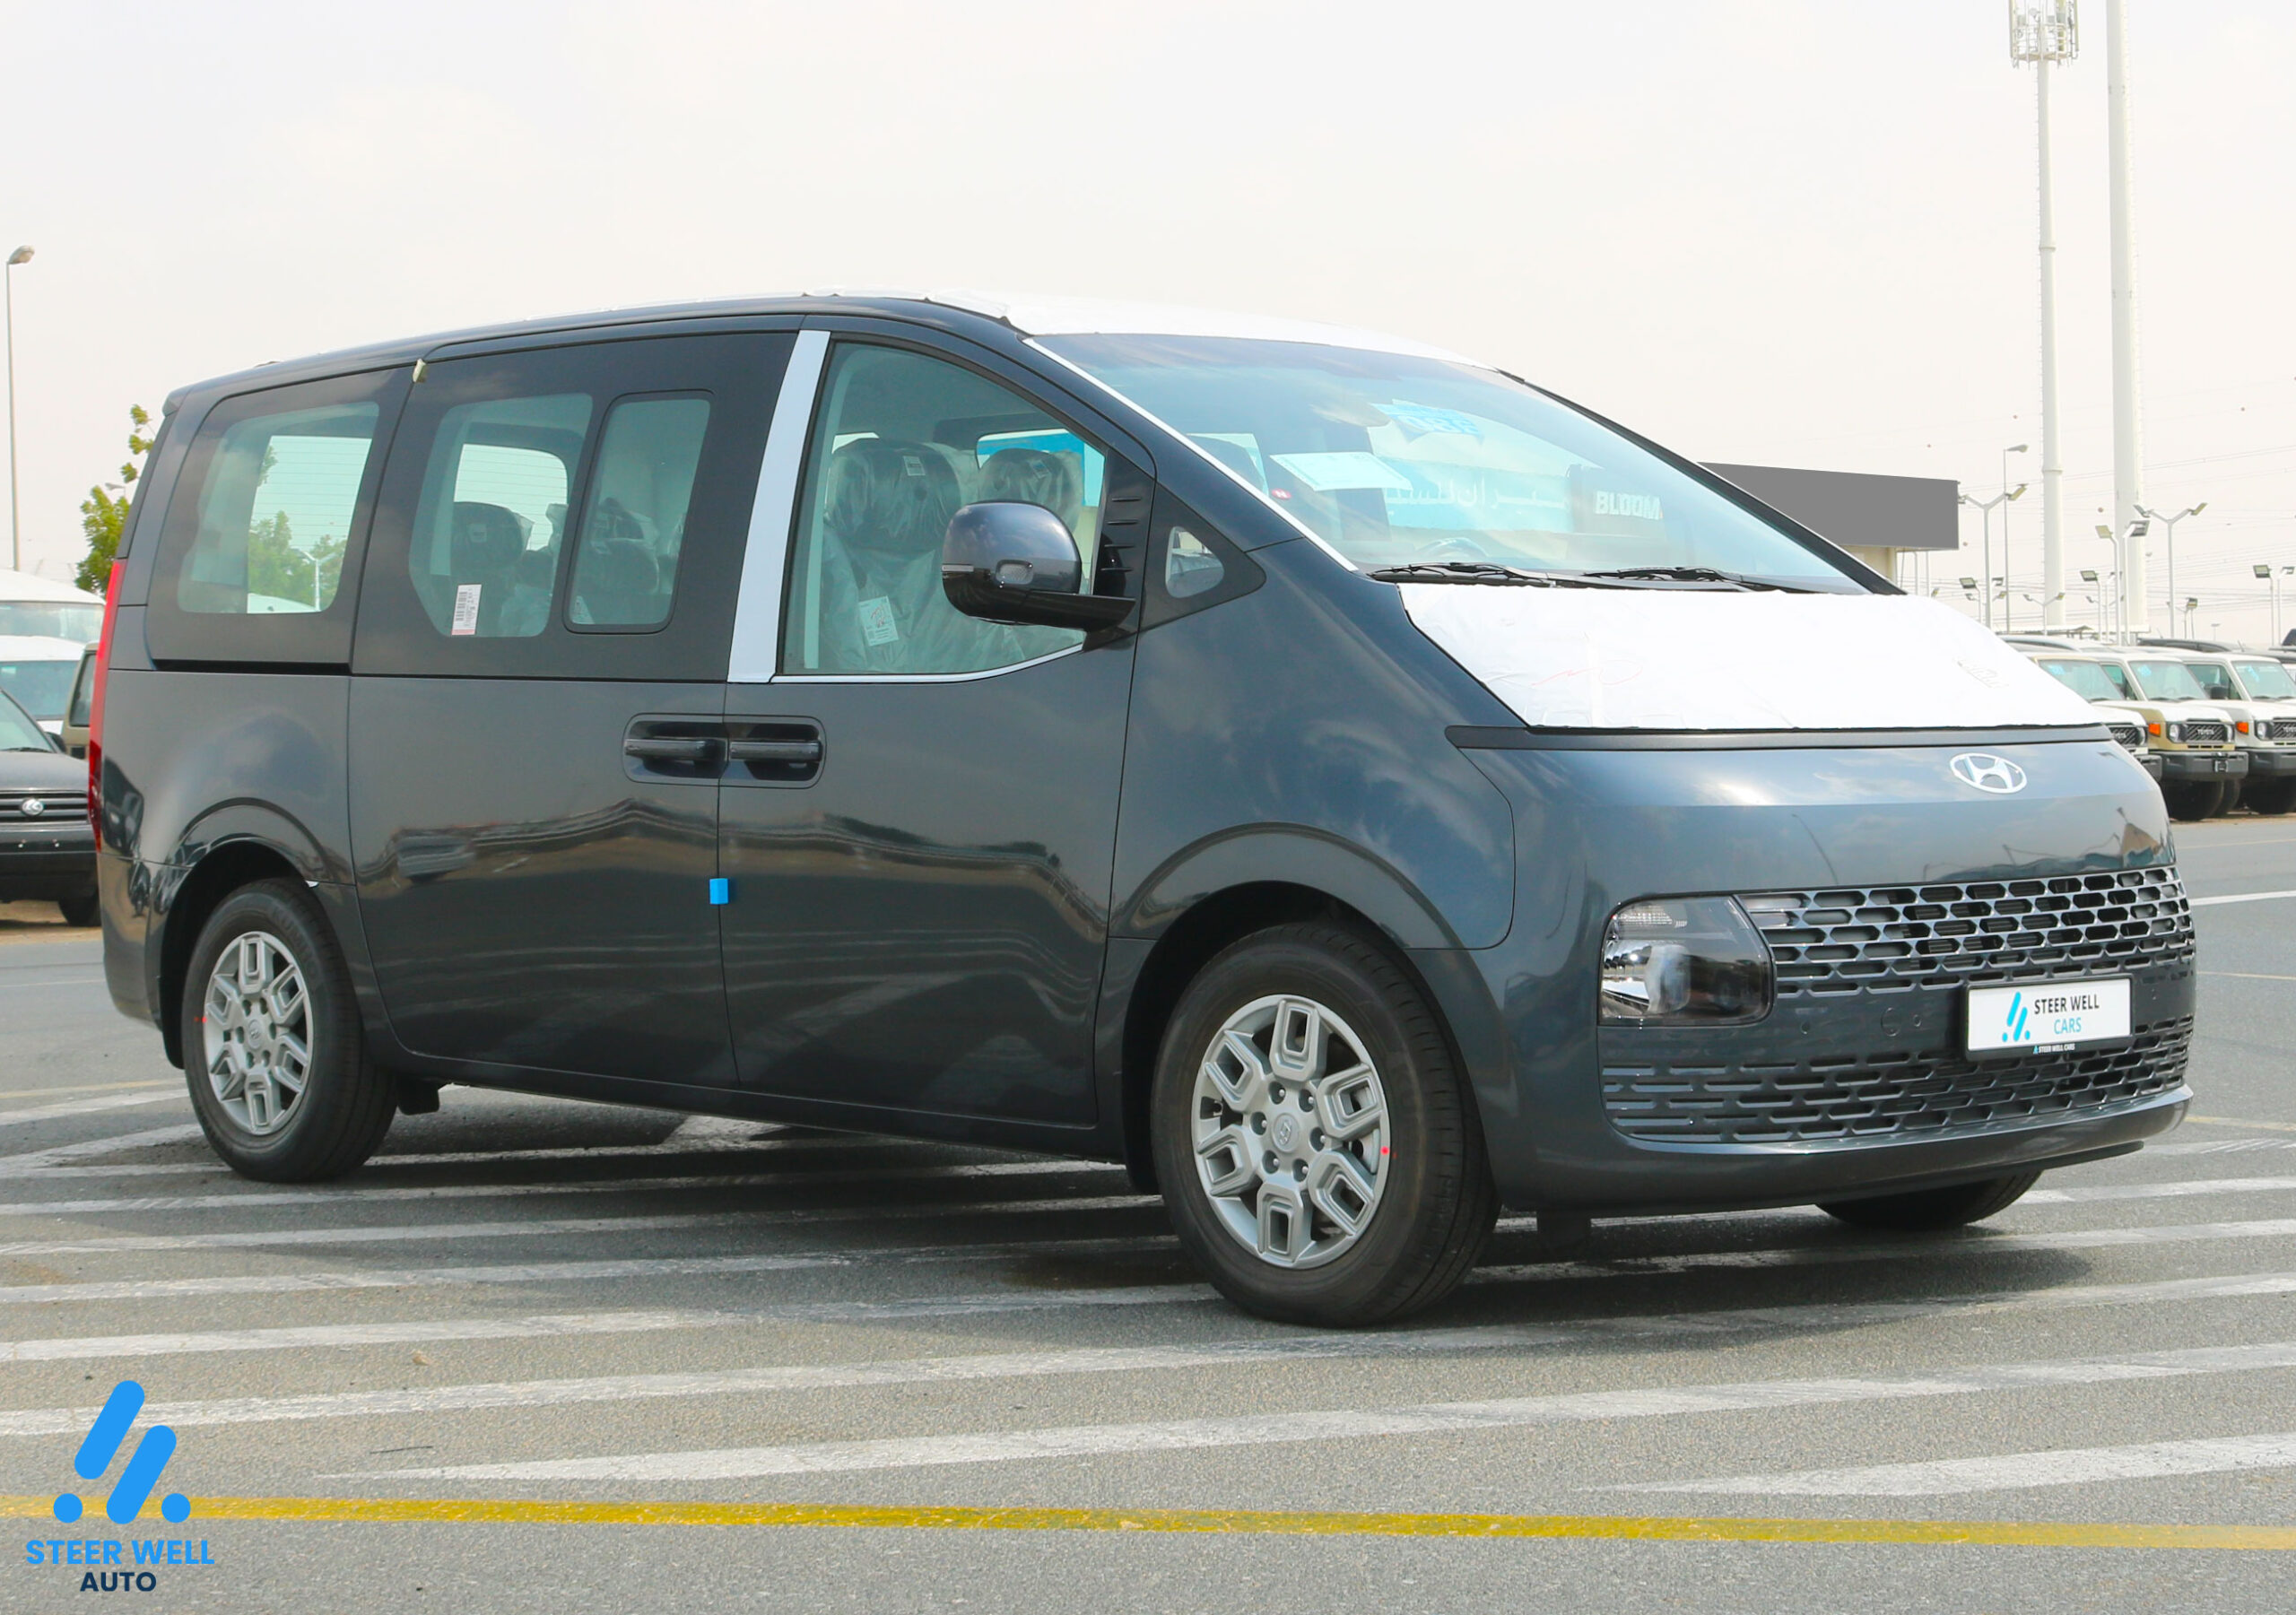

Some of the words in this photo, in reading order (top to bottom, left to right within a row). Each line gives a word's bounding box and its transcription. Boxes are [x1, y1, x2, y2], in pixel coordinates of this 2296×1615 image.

[1594, 490, 1661, 521] BLOOM
[2034, 997, 2067, 1014] STEER
[2070, 994, 2100, 1011] WELL
[2054, 1017, 2082, 1035] CARS
